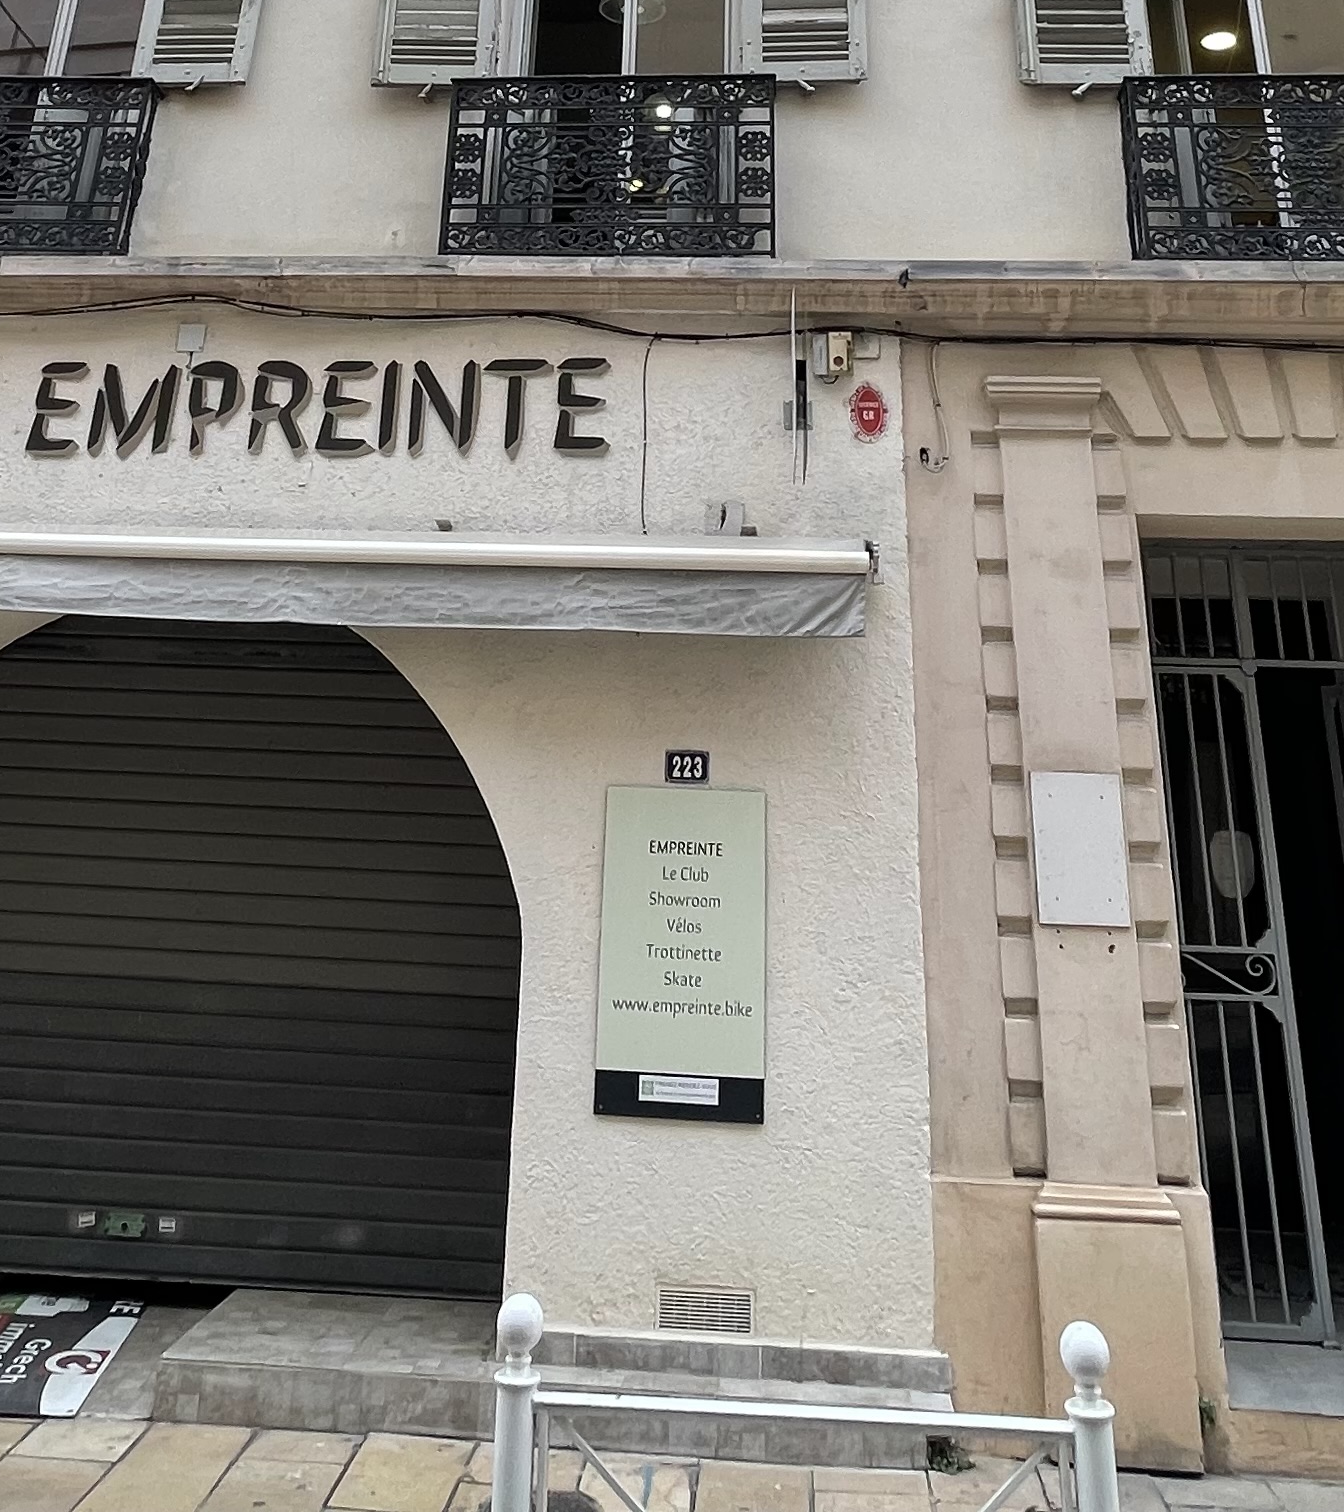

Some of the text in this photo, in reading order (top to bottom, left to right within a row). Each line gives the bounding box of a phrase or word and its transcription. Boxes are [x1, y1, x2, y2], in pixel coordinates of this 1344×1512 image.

[24, 357, 613, 460] EMPREINTE
[672, 755, 703, 779] 223
[649, 840, 723, 857] EMPREINTE
[662, 866, 709, 883] Le Club
[649, 891, 721, 908] Showroom
[666, 916, 702, 934] Vélos
[646, 944, 722, 962] Trottinette
[664, 971, 702, 988] Skate
[612, 998, 753, 1019] www.empreinte.bike
